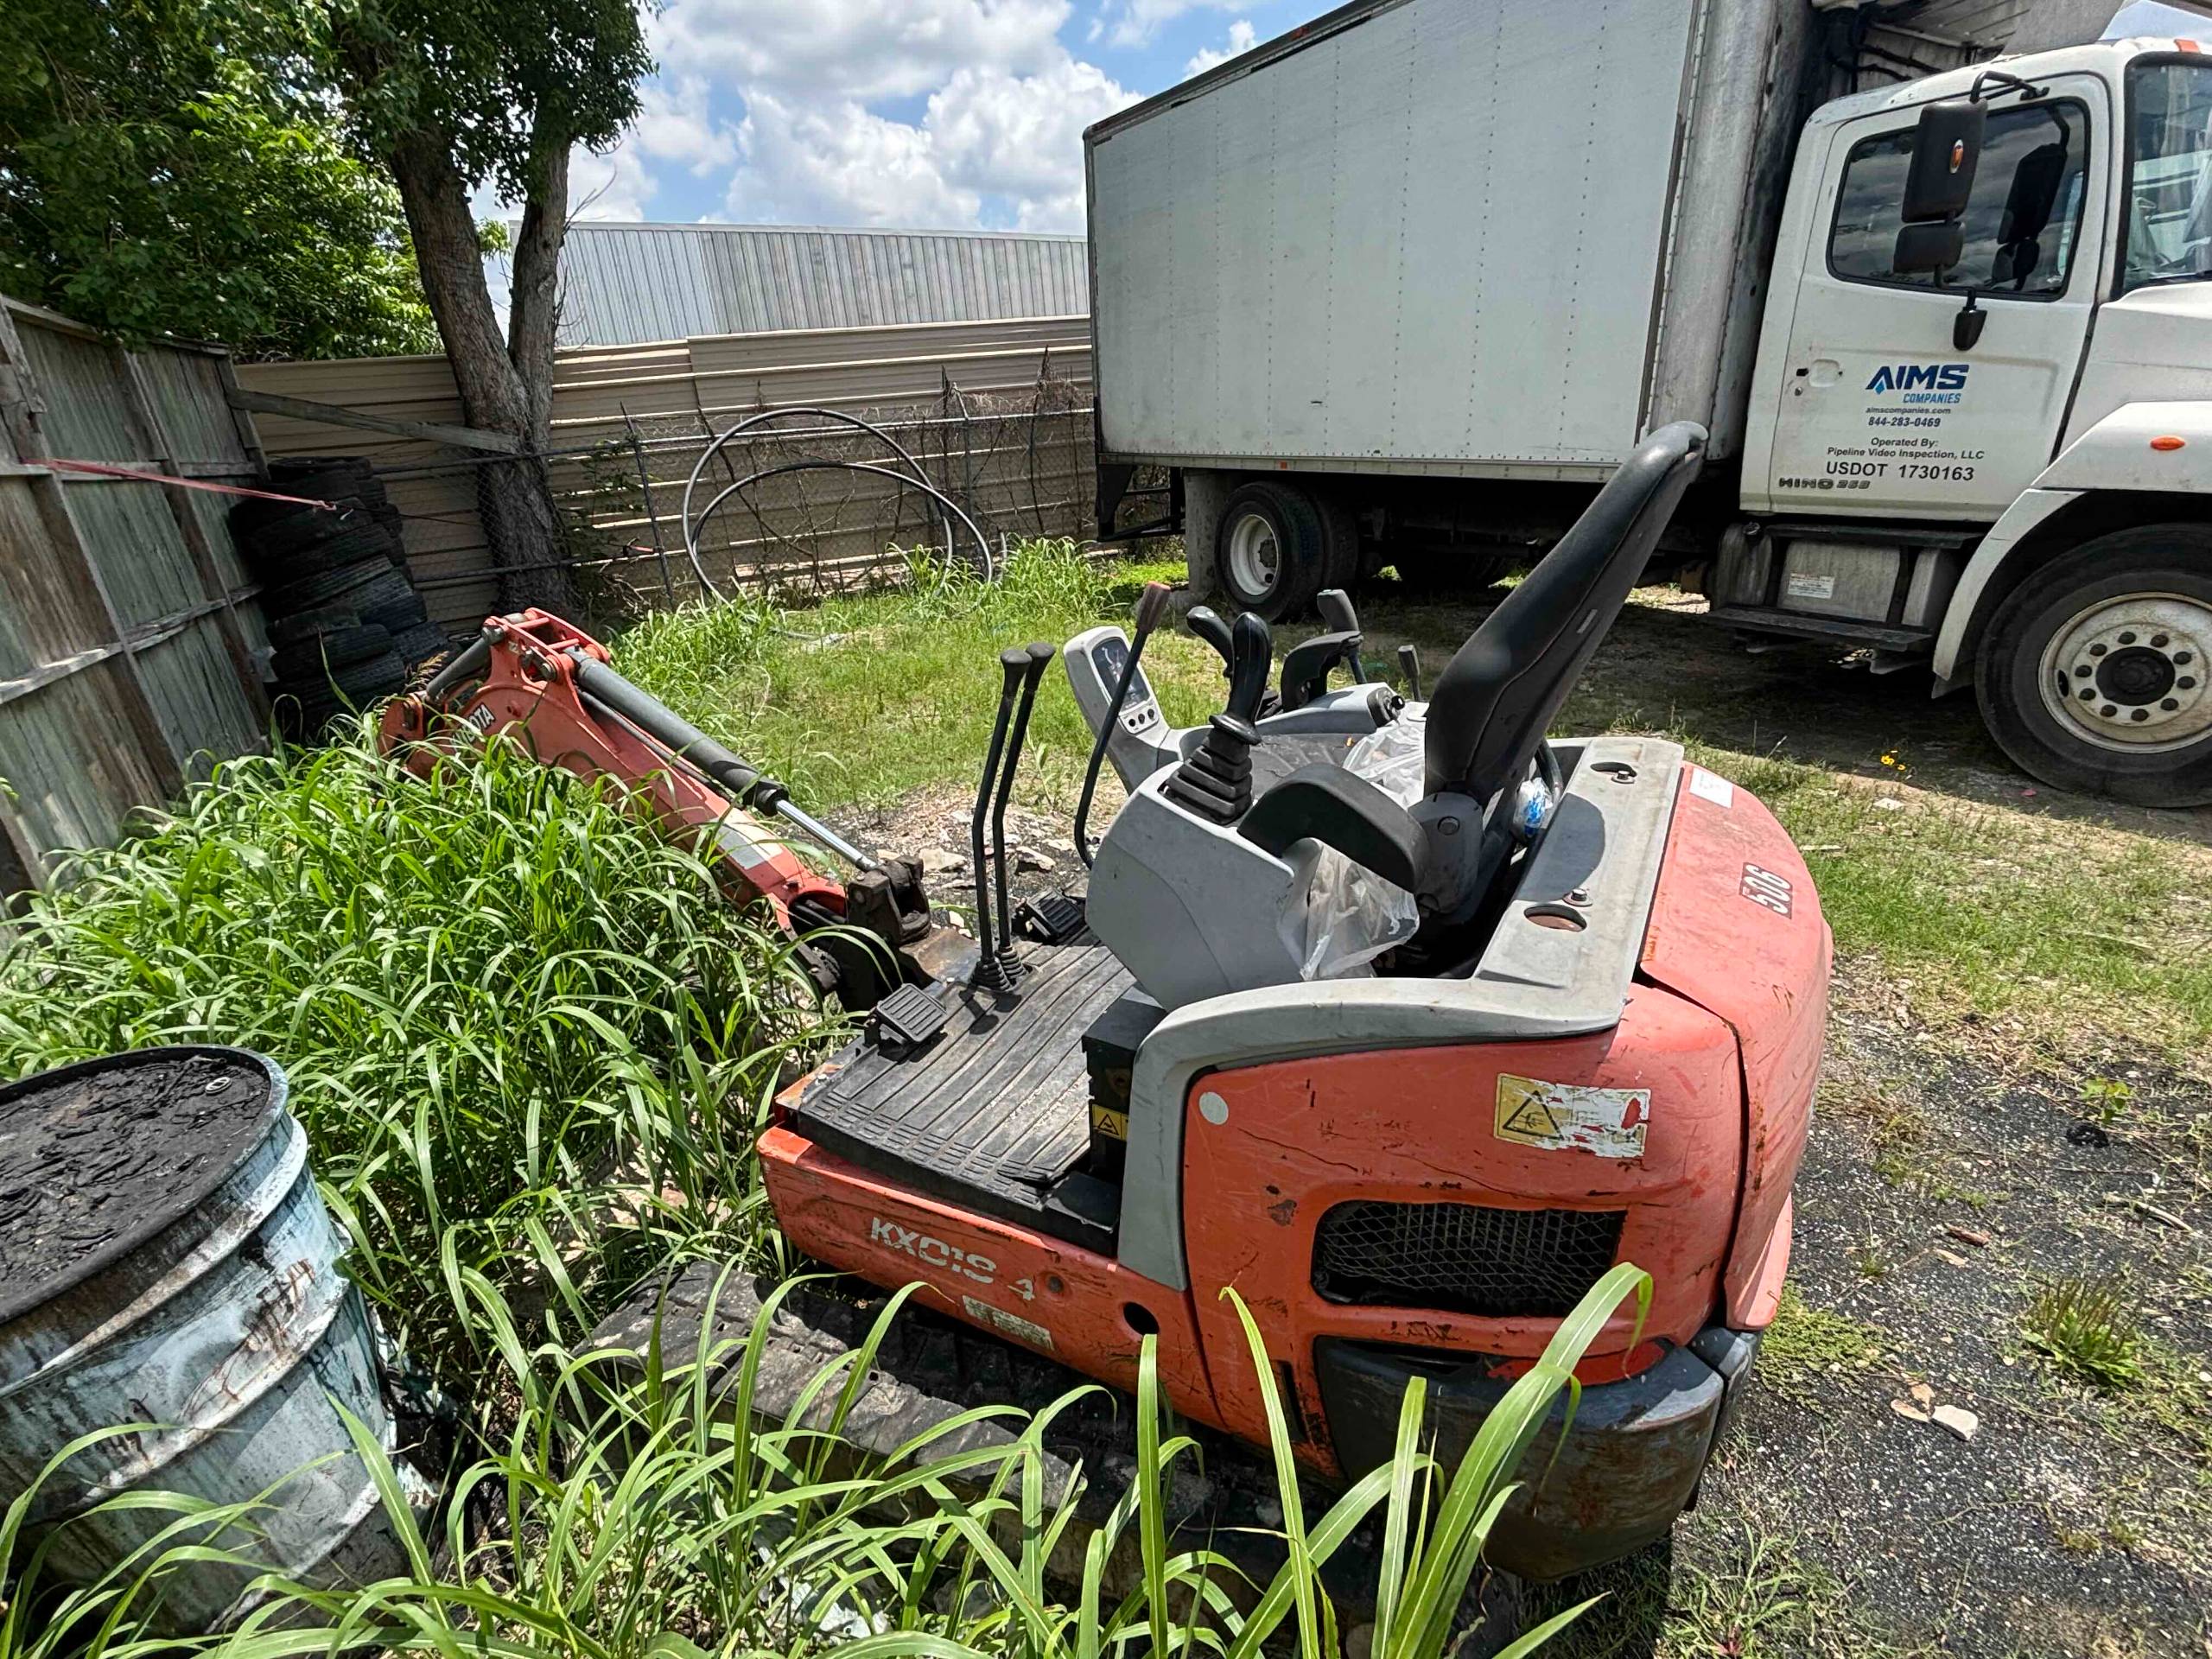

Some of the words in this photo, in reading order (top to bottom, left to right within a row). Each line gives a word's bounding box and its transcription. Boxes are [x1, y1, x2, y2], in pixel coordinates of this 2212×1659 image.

[1866, 365, 1970, 391] AIMS
[1903, 392, 1961, 404] COMPANIES
[1865, 407, 1952, 416] aimscompanies.com
[1867, 416, 1942, 428] 844-283-0469
[1871, 437, 1917, 448] Operated
[1920, 438, 1939, 448] By:
[1827, 447, 1866, 456] Pipeline
[1868, 448, 1897, 458] Video
[1898, 449, 1958, 460] Inspection,
[1961, 450, 1985, 460] LLC
[1826, 461, 1888, 477] USDOT
[1898, 465, 1974, 480] 1730163
[1778, 478, 1834, 490] HINO
[1744, 864, 1791, 914] 506
